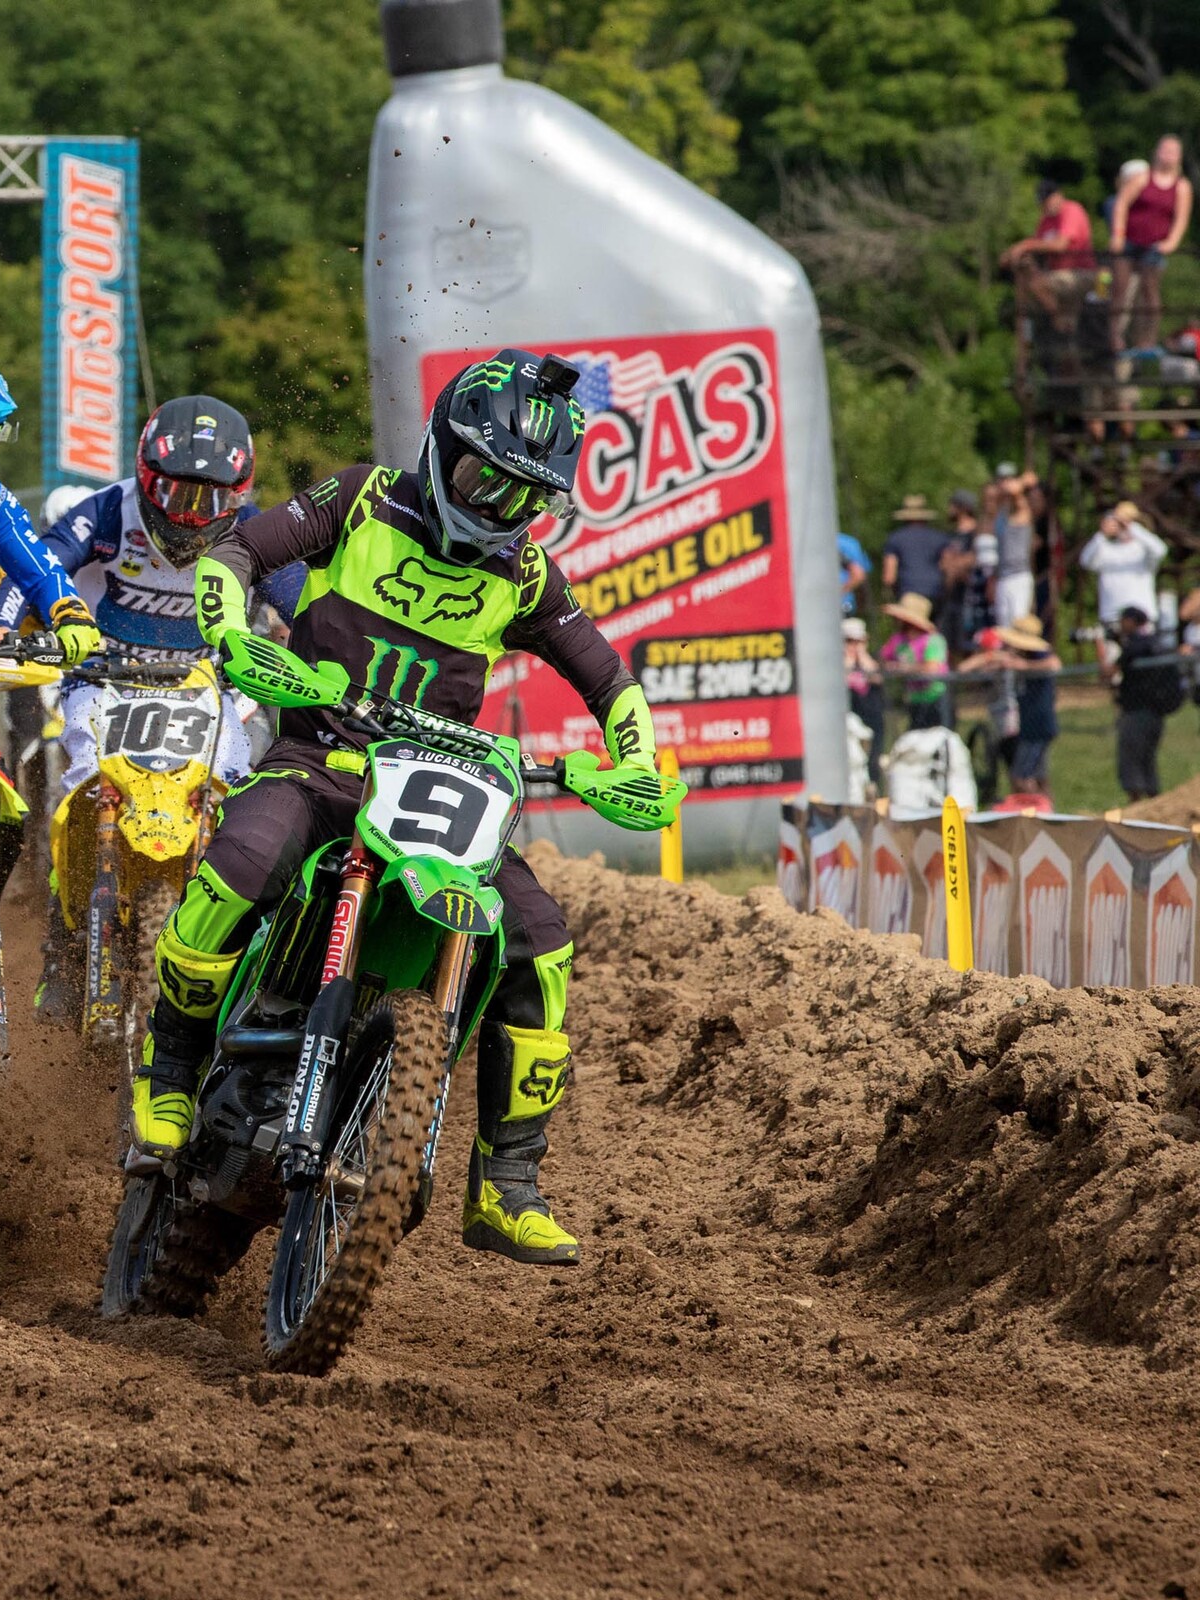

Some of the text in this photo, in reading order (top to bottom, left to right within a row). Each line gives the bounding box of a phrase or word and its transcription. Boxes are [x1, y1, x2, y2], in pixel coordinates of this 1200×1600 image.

[483, 421, 494, 442] FOX
[528, 343, 776, 552] CAS
[382, 494, 424, 525] Kawasak
[704, 511, 763, 568] OIL
[201, 575, 225, 630] FOX
[646, 632, 786, 667] SYNTHETIC
[135, 689, 166, 698] LUCAS
[240, 667, 321, 700] ACERBIS
[641, 664, 696, 704] SAE
[105, 702, 211, 755] 103
[416, 751, 460, 768] LUCAS
[462, 763, 481, 778] OIL
[389, 769, 490, 857] 9
[583, 786, 663, 818] ACERBIS
[368, 826, 403, 857] Kawasaki
[947, 825, 958, 900] ACERBIS
[287, 1034, 315, 1133] DUNLOP
[303, 1073, 325, 1134] CARRILLO
